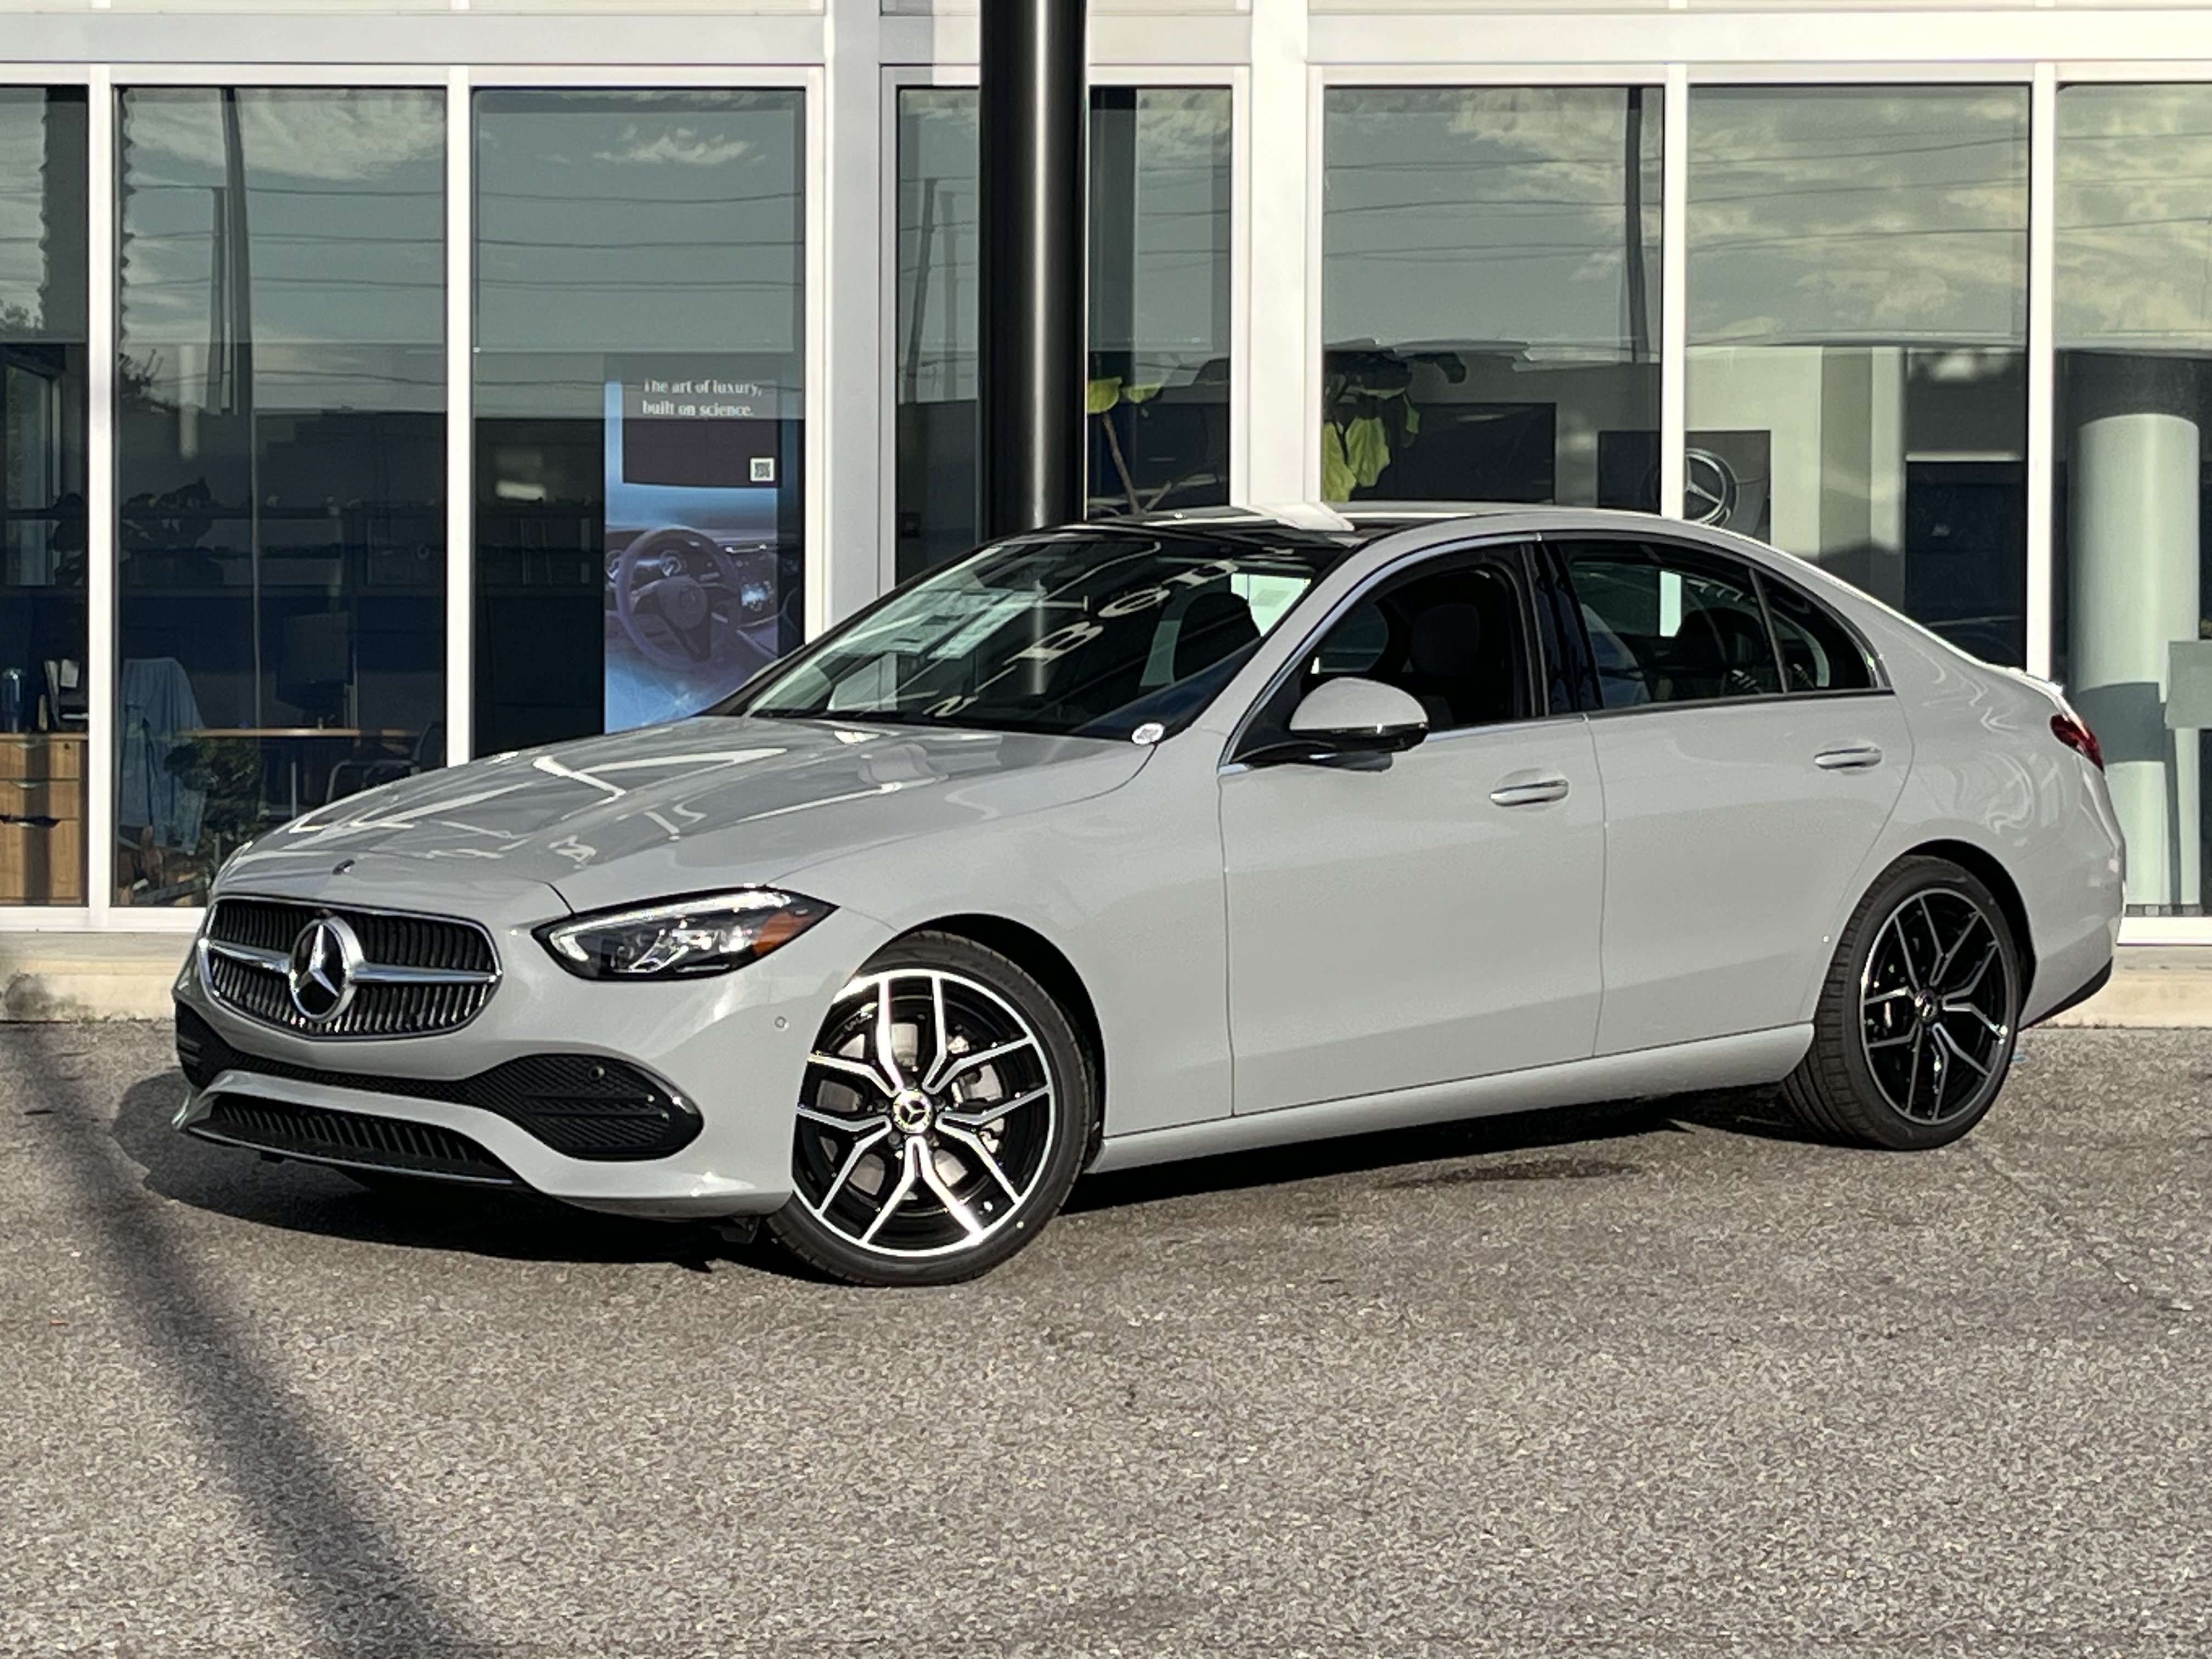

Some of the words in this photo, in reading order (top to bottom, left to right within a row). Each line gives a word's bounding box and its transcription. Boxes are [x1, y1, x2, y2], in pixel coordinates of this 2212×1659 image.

[672, 381, 692, 393] art
[695, 380, 712, 393] of
[713, 379, 763, 397] luxury,
[642, 400, 675, 415] built
[678, 405, 696, 416] on
[699, 402, 754, 416] science.
